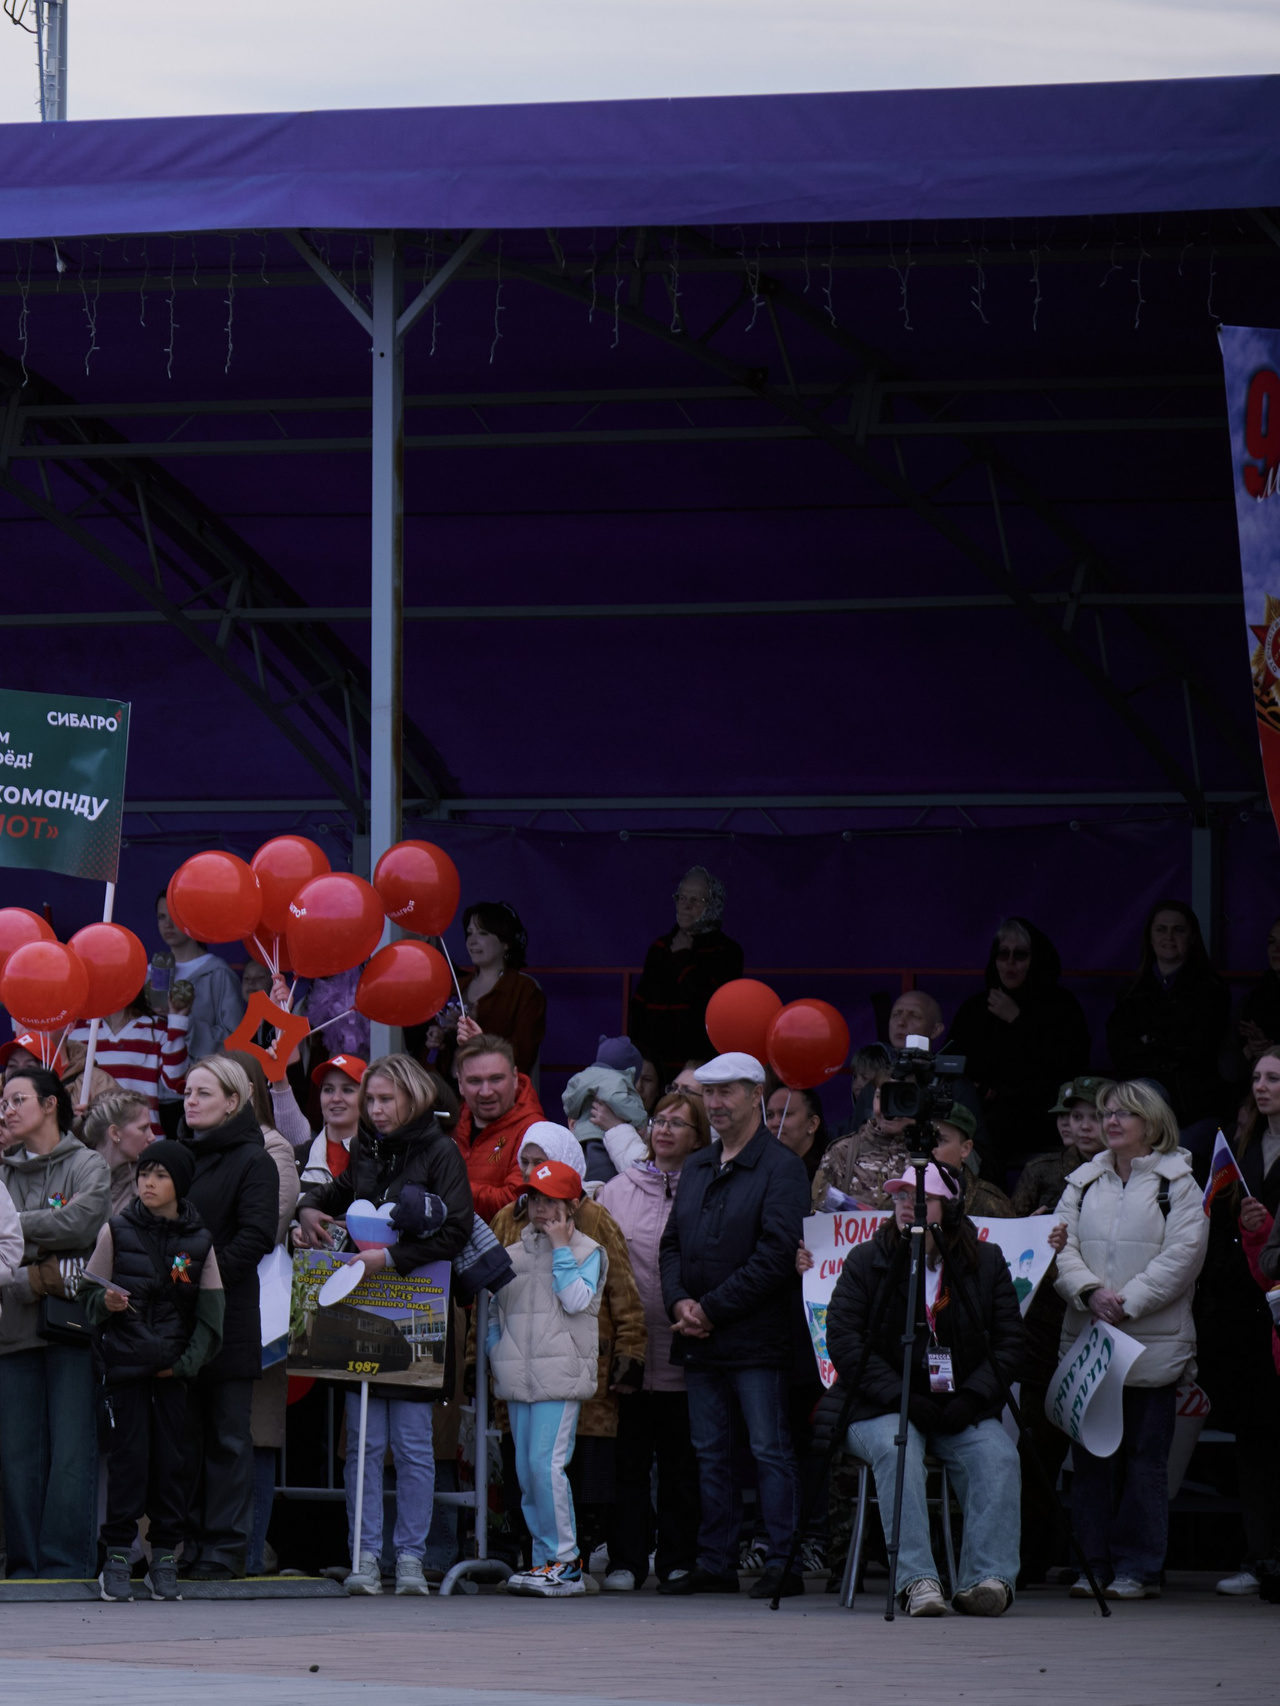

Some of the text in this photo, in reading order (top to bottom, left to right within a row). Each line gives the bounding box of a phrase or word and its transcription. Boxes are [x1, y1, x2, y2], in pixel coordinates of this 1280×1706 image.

[47, 710, 118, 732] СИБАГРО
[21, 1014, 63, 1025] СИБАГРО
[382, 1283, 444, 1294] учреждение
[406, 1303, 430, 1311] вида
[346, 1360, 380, 1375] 1987
